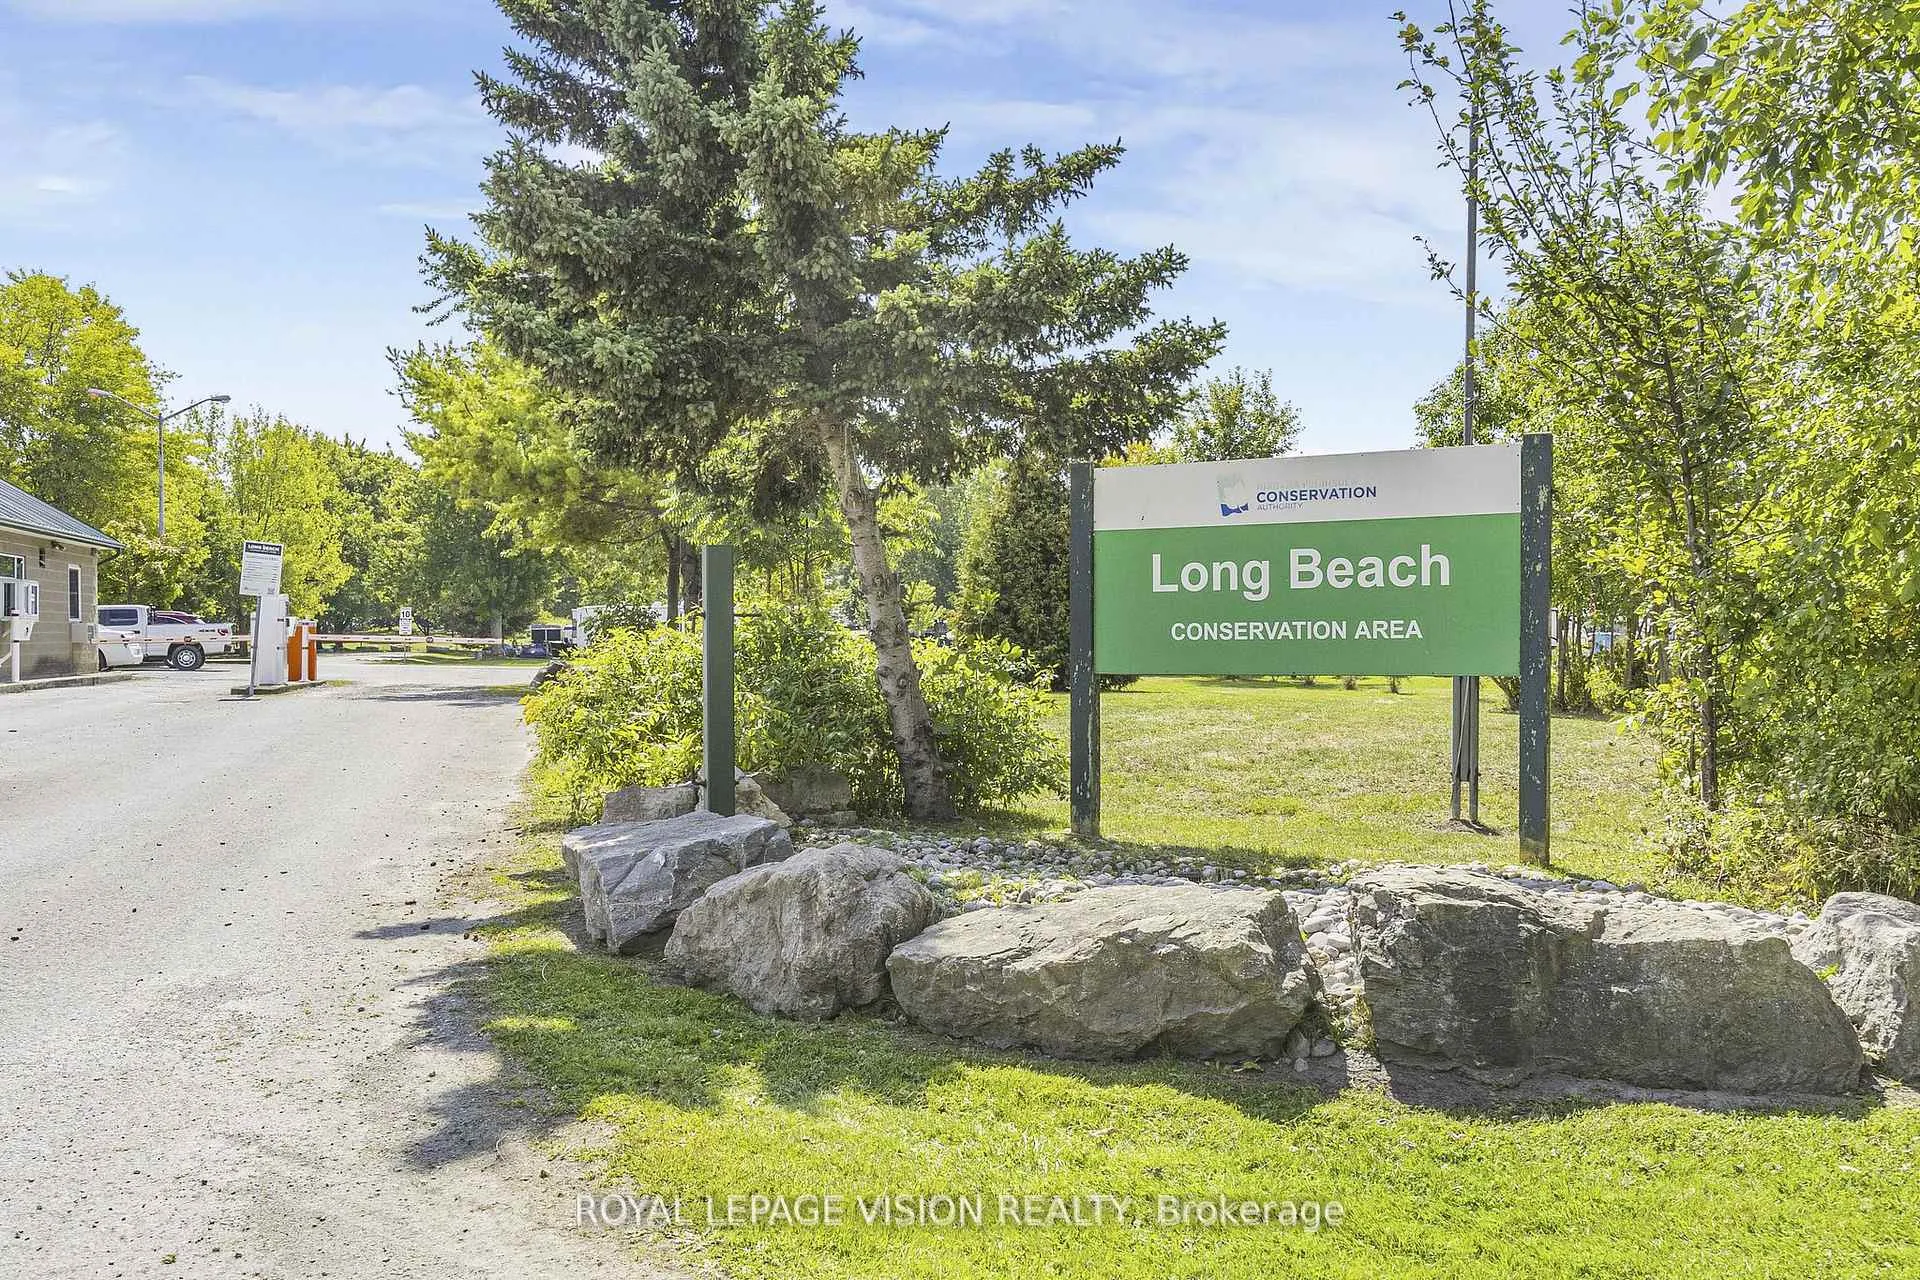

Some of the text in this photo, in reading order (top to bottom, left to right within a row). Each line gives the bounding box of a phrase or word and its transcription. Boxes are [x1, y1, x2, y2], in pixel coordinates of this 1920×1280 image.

[1256, 486, 1377, 503] CONSERVATION
[1256, 502, 1304, 511] AUTHORITY
[1152, 544, 1450, 601] Long Beach
[1171, 620, 1424, 641] CONSERVATION AREA
